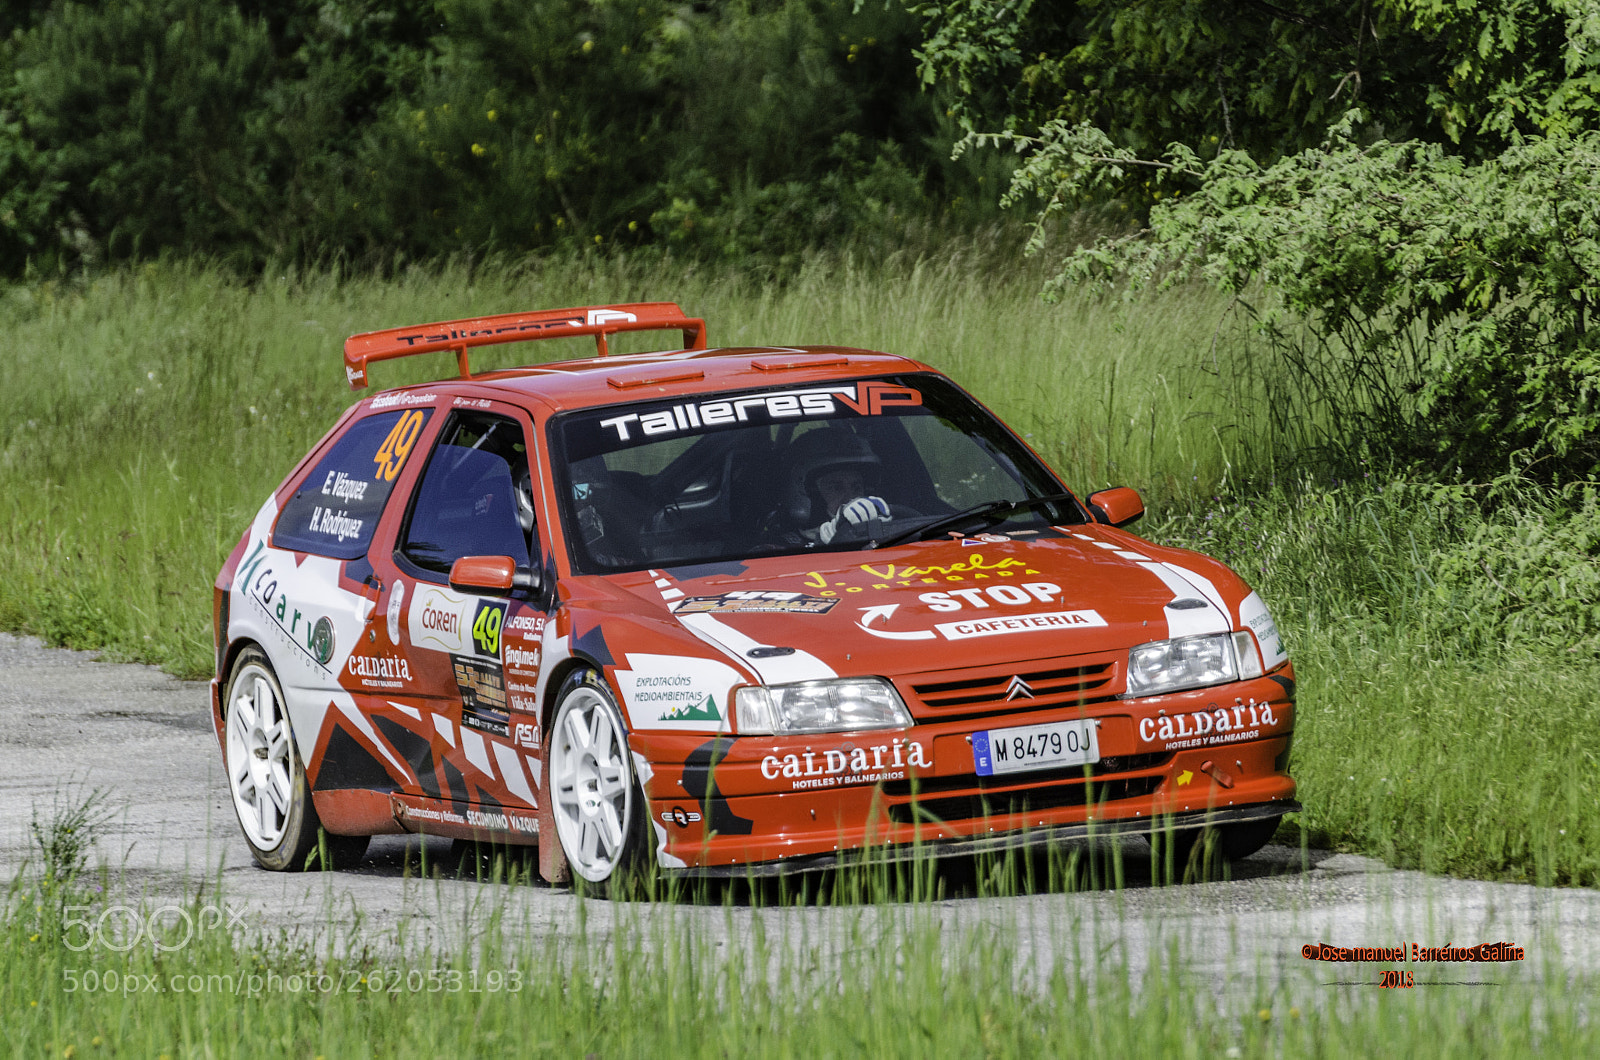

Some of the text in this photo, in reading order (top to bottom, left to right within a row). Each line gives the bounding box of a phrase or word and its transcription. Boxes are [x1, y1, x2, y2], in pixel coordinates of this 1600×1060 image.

[373, 409, 424, 482] 49
[321, 470, 368, 504] E. Vázquez
[309, 505, 363, 542] H. Rodríguez
[859, 553, 1026, 580] Varela
[819, 567, 1041, 597] CORTEGADA
[918, 582, 1062, 612] STOP
[472, 605, 502, 654] 49
[953, 613, 1090, 636] CAFETERIA
[636, 674, 691, 687] EXPLOTACIÓNS
[635, 691, 703, 702] MEDIOAMBIENTAIS
[994, 738, 1008, 762] M
[1013, 732, 1062, 760] 8479
[1165, 730, 1259, 750] HOTELES Y BALNEARIOS
[980, 757, 988, 767] E
[792, 771, 904, 789] HOTELES Y BALNEARIOS
[466, 810, 509, 829] SECUNDINO
